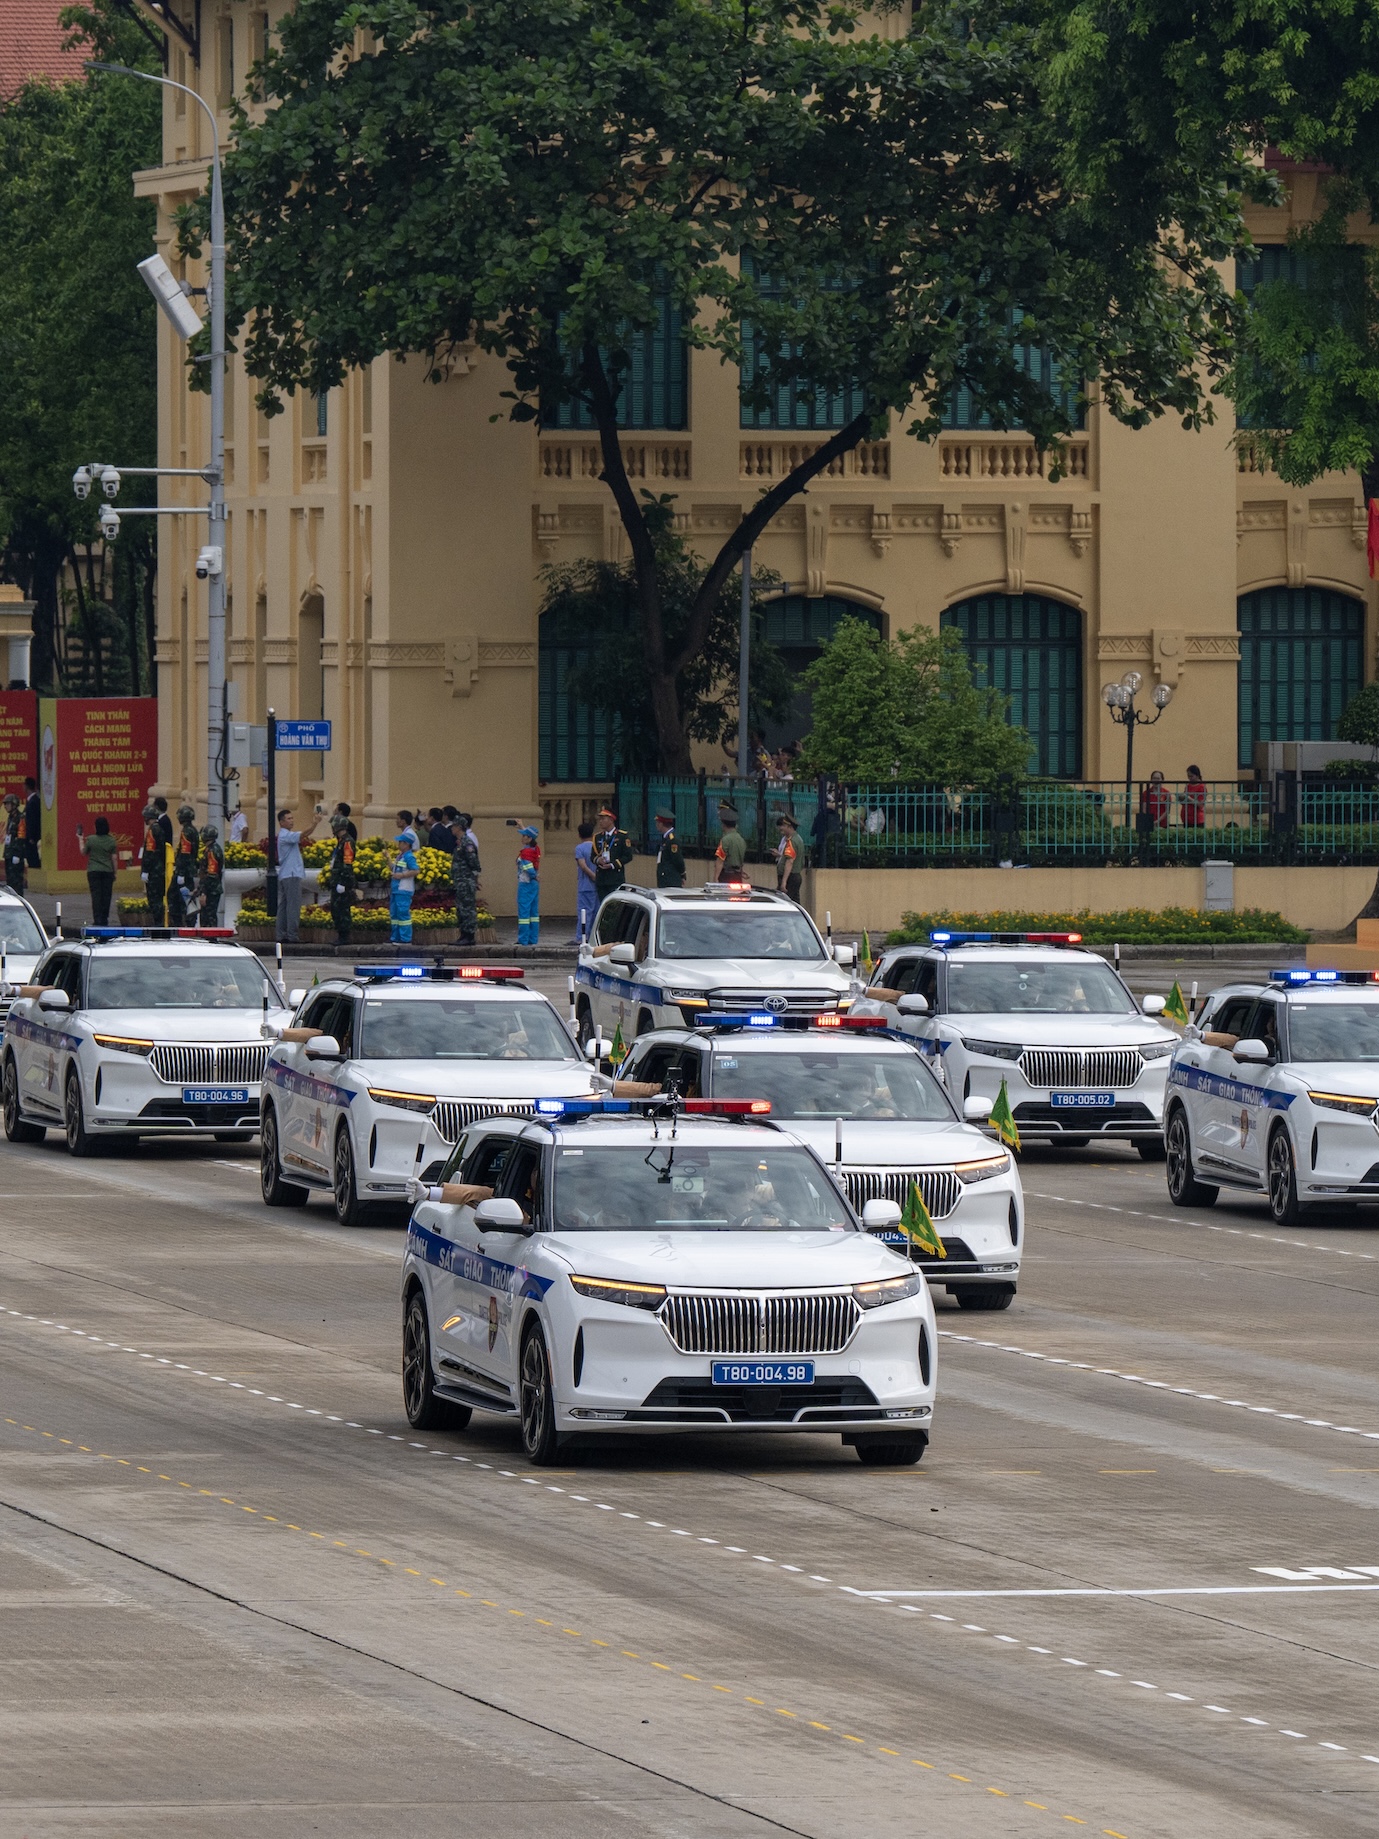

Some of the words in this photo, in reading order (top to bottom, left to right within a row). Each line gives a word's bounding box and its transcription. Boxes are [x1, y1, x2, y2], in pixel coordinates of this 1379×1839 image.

[86, 711, 105, 720] TINH
[84, 724, 104, 733] CÁCH
[83, 737, 110, 746] THÁNG
[112, 736, 130, 746] TÁM
[280, 733, 300, 745] HOÀNG
[302, 733, 314, 745] VĂN
[69, 750, 80, 759] VÀ
[134, 751, 147, 759] 2-9
[95, 790, 110, 798] CÁC
[86, 802, 105, 813] VIỆT
[106, 804, 126, 812] NAM
[1197, 1075, 1212, 1093] SÁT
[1218, 1083, 1236, 1100] GIAO
[439, 1245, 455, 1271] SÁT
[464, 1258, 483, 1281] GIAO
